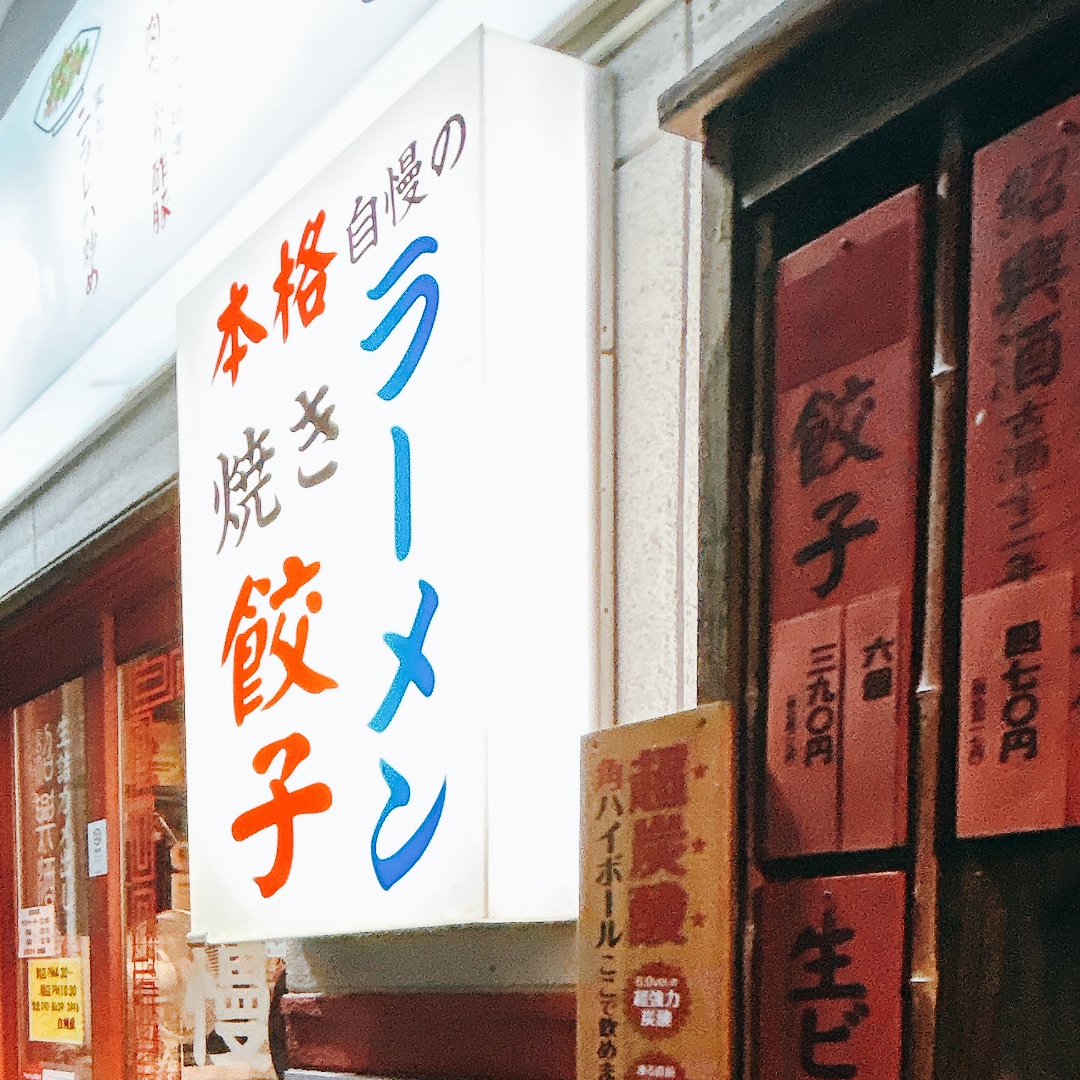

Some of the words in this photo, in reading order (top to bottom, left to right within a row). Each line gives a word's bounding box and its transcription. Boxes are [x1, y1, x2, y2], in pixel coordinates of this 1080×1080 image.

[347, 113, 467, 264] 自慢の
[211, 209, 338, 387] 本格
[213, 385, 340, 555] 焼き
[360, 235, 447, 892] ラーメン
[792, 375, 883, 598] 餃子
[221, 556, 339, 898] 餃子
